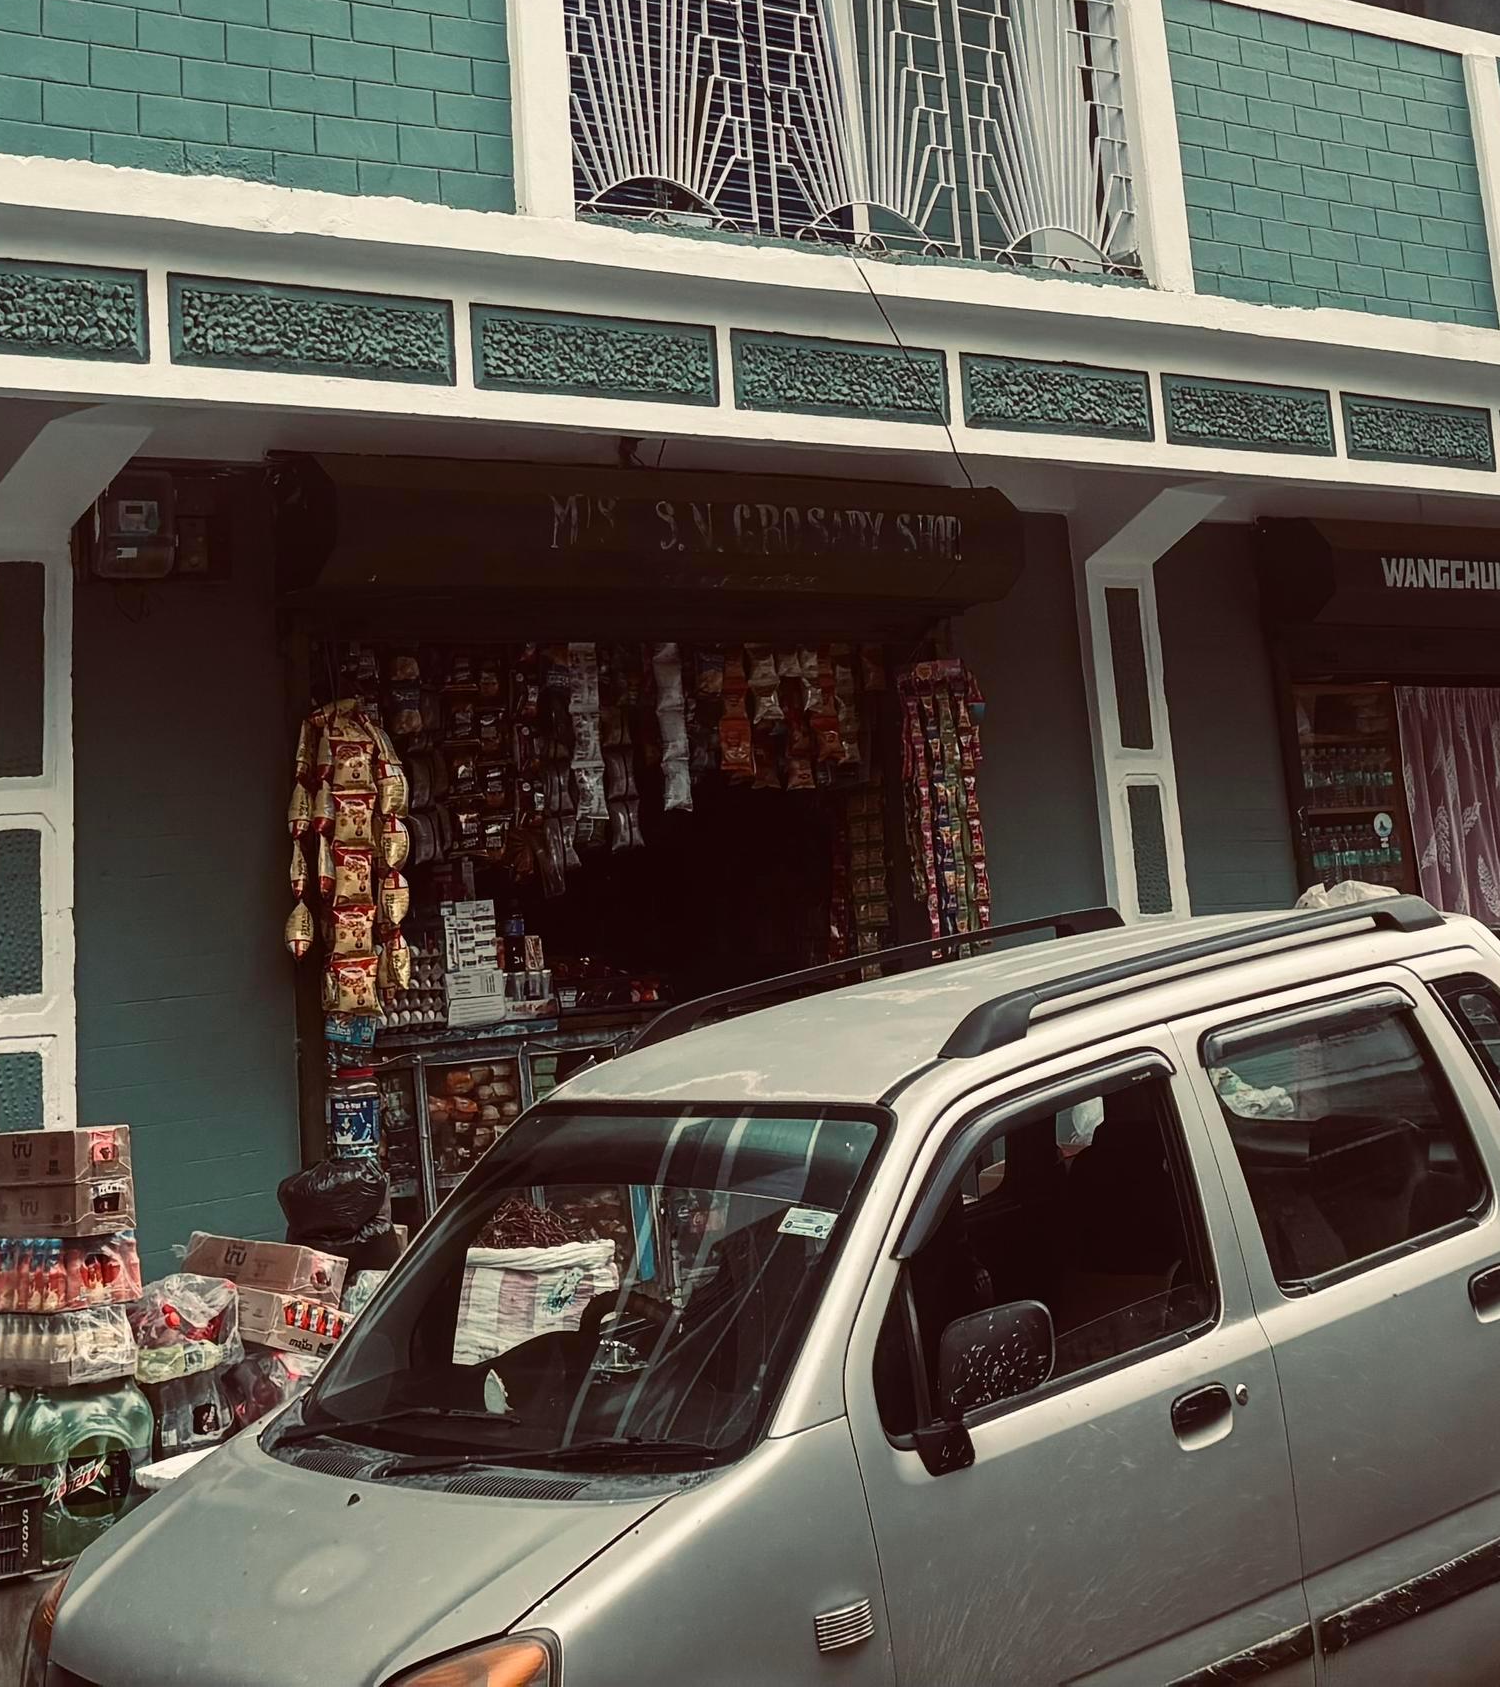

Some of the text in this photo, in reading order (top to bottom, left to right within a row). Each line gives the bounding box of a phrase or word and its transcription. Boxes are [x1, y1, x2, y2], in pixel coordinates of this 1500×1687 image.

[11, 1140, 33, 1160] tru
[20, 1198, 39, 1217] tru
[224, 1244, 248, 1266] tru
